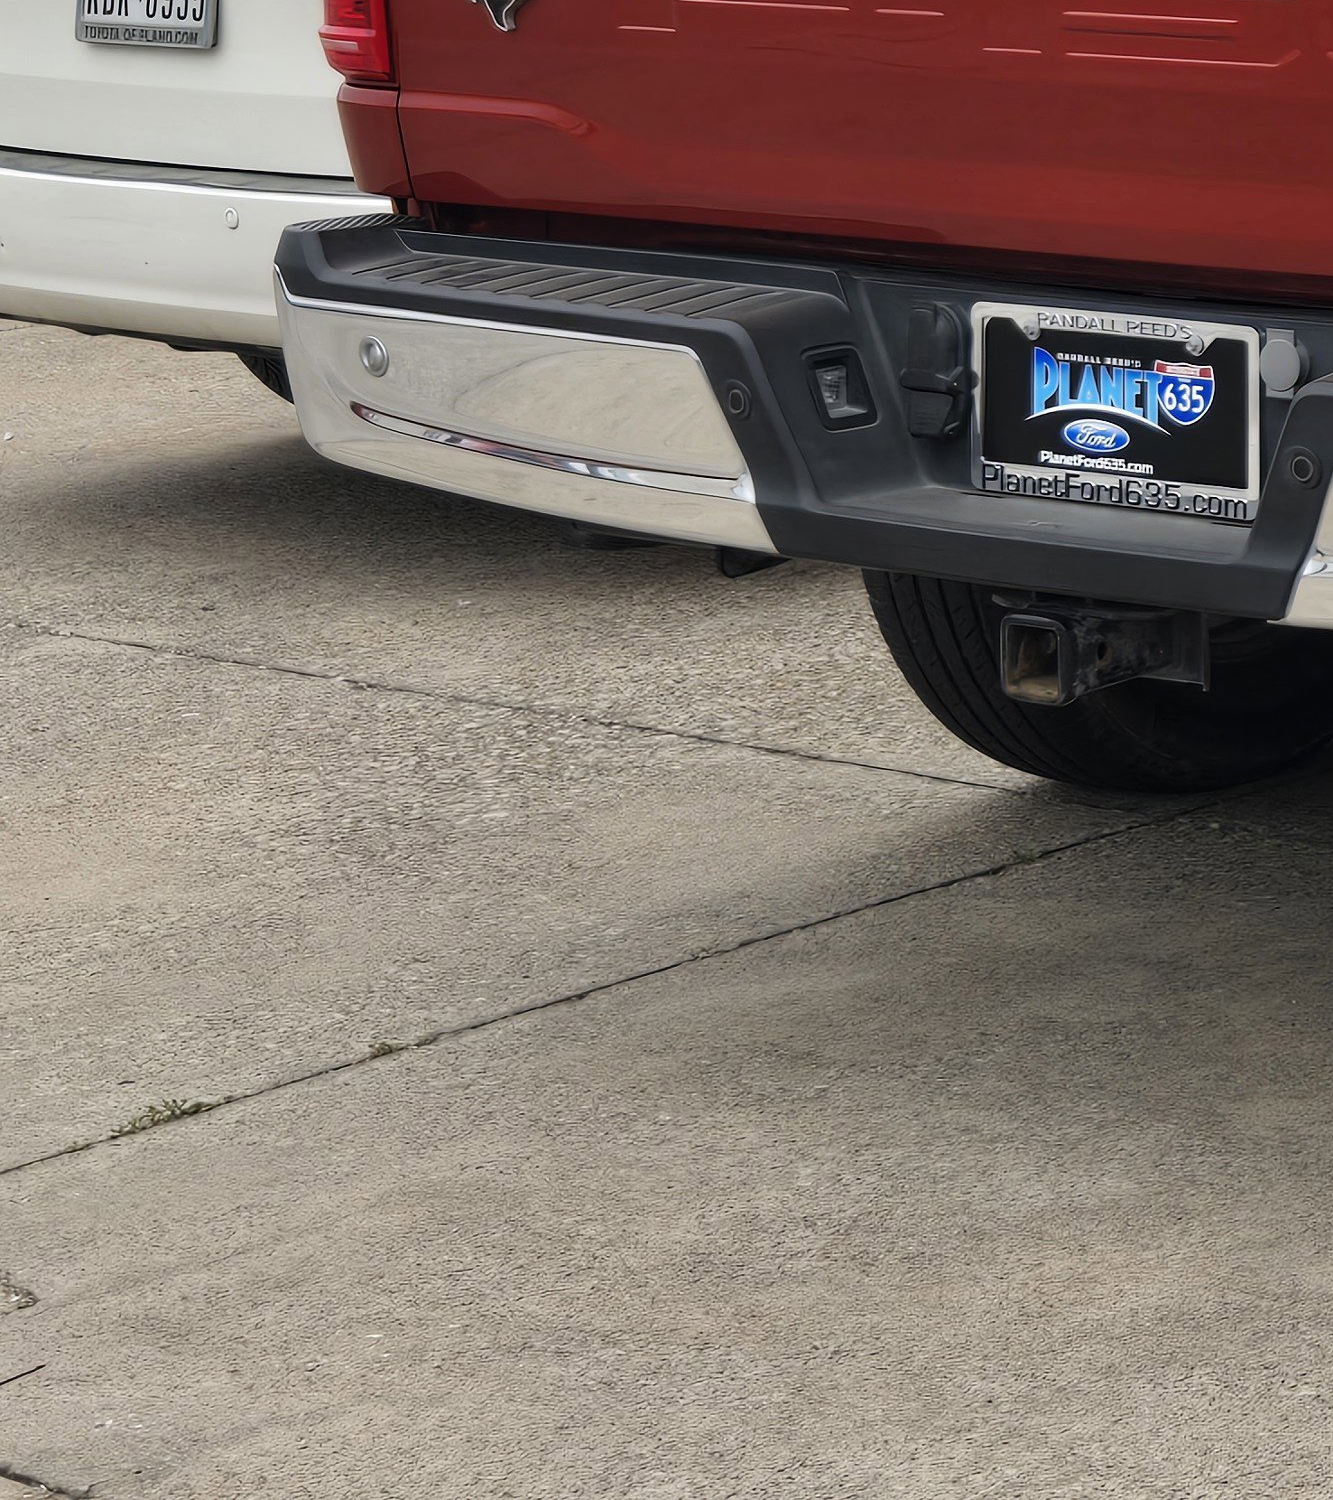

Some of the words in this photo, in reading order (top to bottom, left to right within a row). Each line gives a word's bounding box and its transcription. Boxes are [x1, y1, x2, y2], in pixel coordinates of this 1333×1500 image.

[1037, 312, 1124, 334] RANDALL
[1126, 320, 1194, 340] REED'S
[1033, 346, 1163, 427] PLANET
[1164, 380, 1205, 414] 635
[1074, 421, 1117, 448] Ford
[981, 463, 1248, 519] PlanetFord635.com
